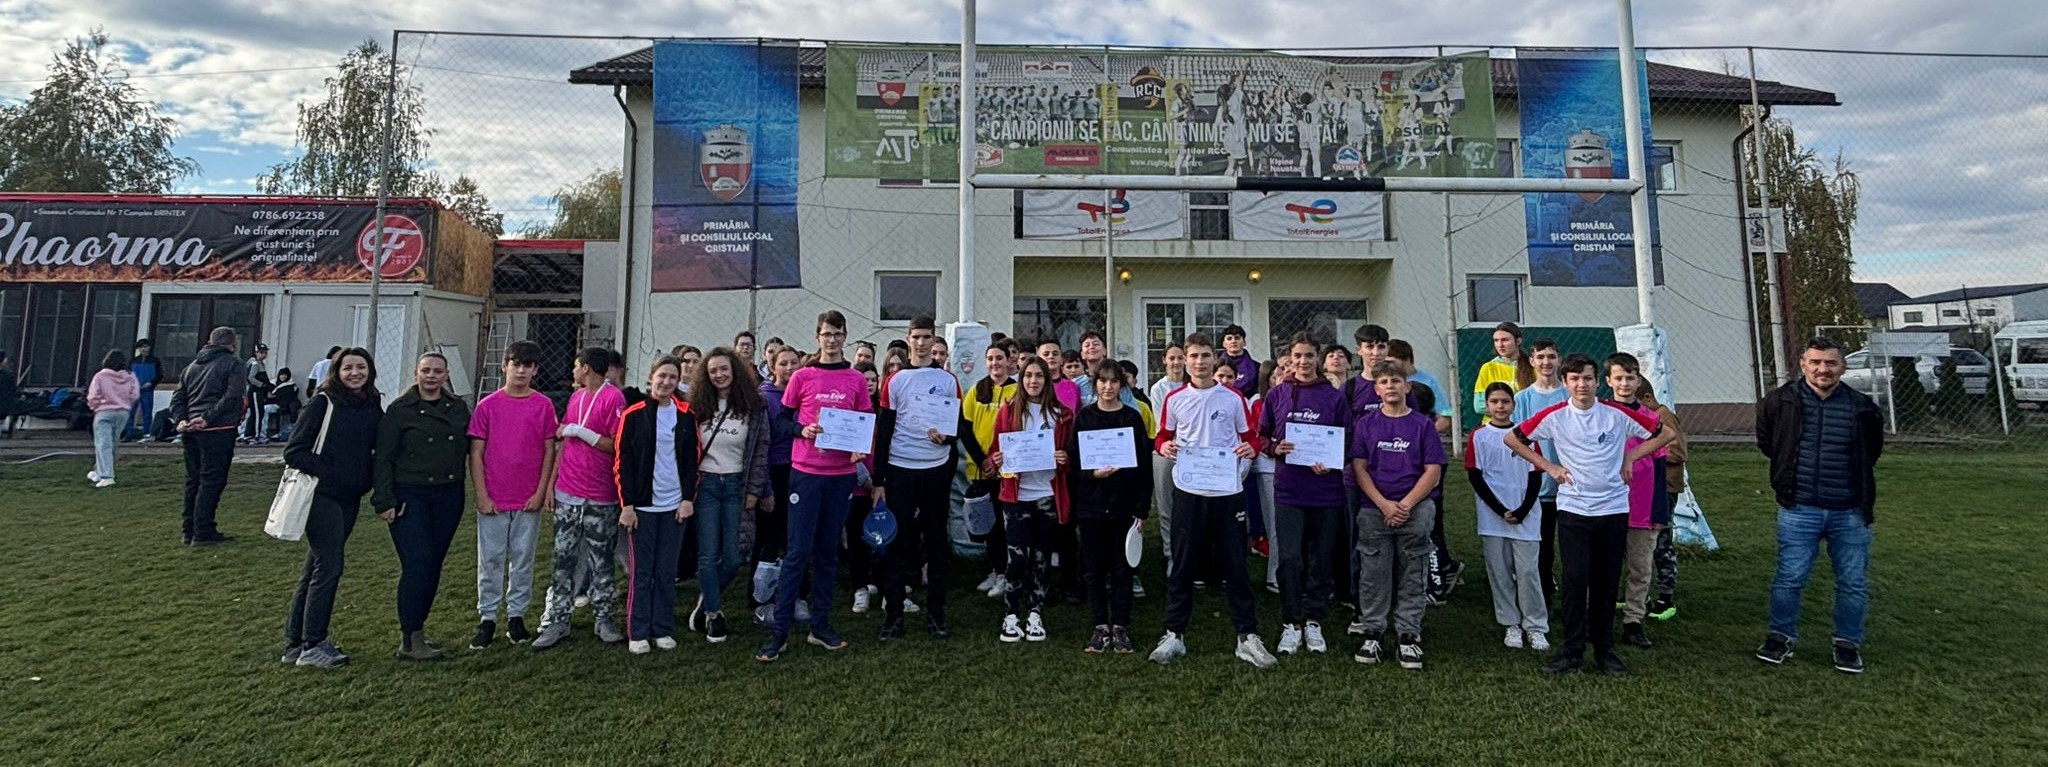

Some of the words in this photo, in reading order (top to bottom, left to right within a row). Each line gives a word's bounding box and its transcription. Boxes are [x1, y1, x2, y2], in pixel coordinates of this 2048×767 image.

[1136, 84, 1162, 98] RCC
[1078, 120, 1099, 141] SE
[1103, 121, 1137, 142] FAC,
[1250, 123, 1271, 143] NU
[1275, 124, 1295, 143] SE
[1105, 145, 1163, 154] Comunitatea
[252, 210, 325, 220] 0786.692.258
[703, 219, 750, 231] PRIMĂRIA
[1570, 220, 1615, 231] PRIMĂRIA
[234, 225, 250, 236] Ne
[317, 227, 339, 238] prin
[1286, 228, 1339, 237] TotalEnergies
[1560, 232, 1606, 241] CONSILIUL
[691, 233, 742, 243] CONSILIUL
[743, 232, 774, 241] LOCAL
[255, 240, 280, 250] gust
[281, 239, 304, 249] unic
[705, 243, 750, 253] CRISTIAN
[1573, 243, 1615, 252] CRISTIAN
[251, 253, 318, 265] originalitate!
